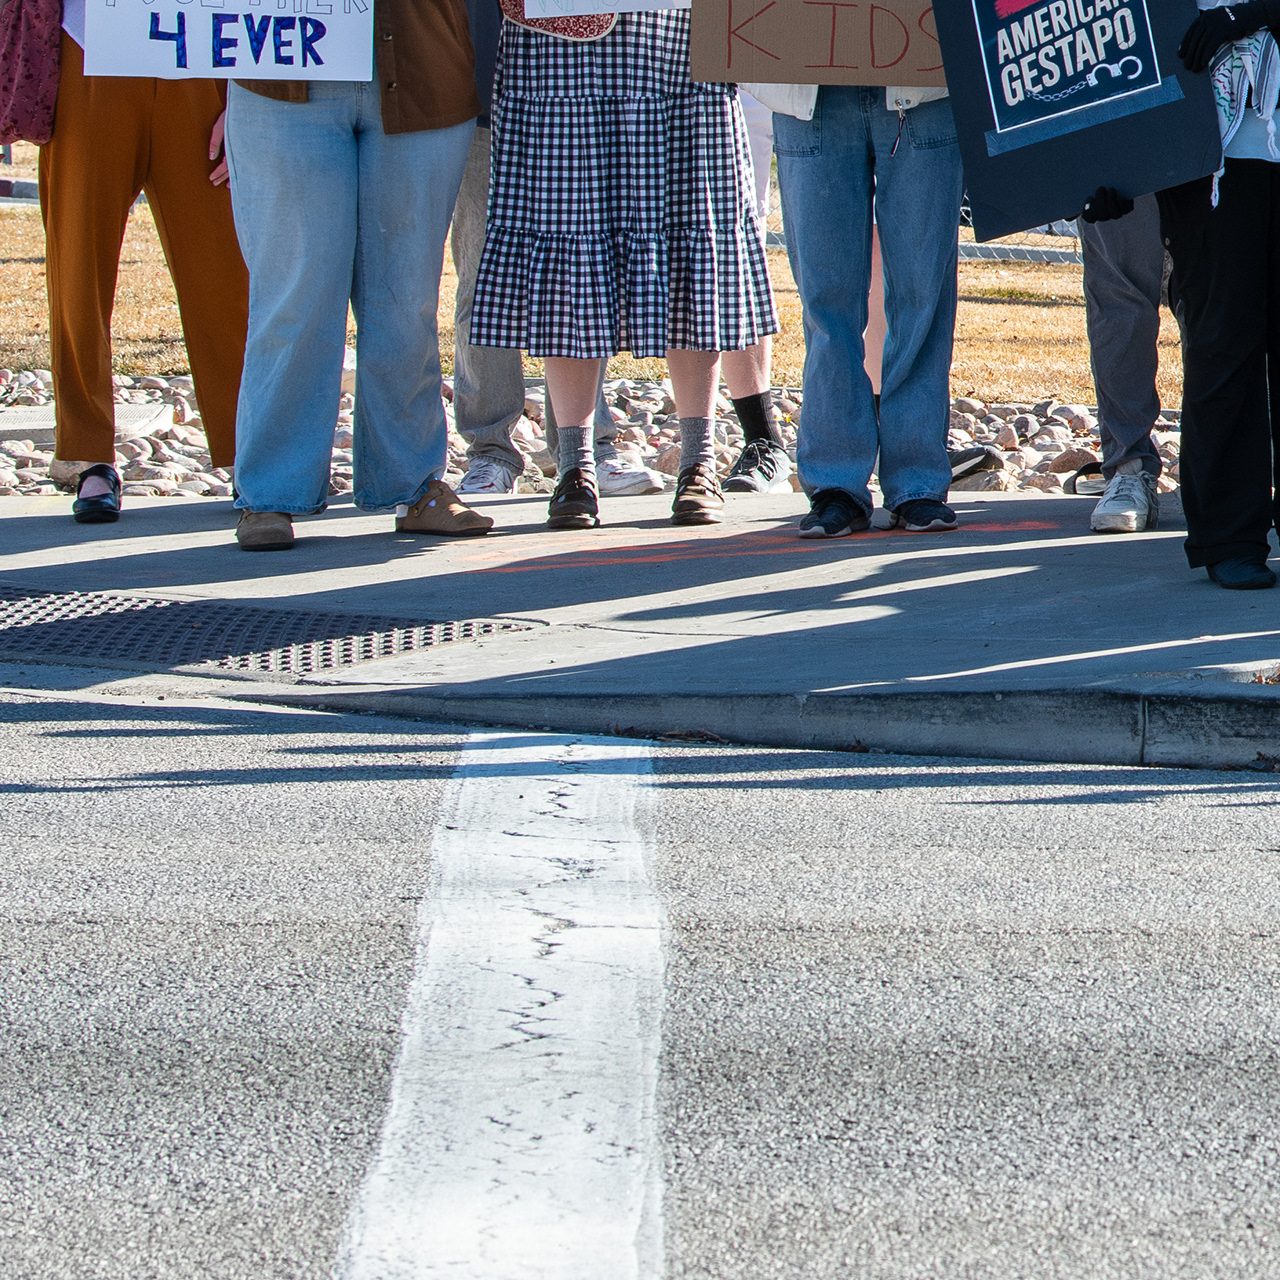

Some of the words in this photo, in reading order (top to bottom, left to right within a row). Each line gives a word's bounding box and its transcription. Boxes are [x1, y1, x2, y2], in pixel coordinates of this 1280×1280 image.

[149, 11, 188, 69] 4
[211, 12, 327, 68] EVER
[999, 7, 1137, 107] GESTAPO
